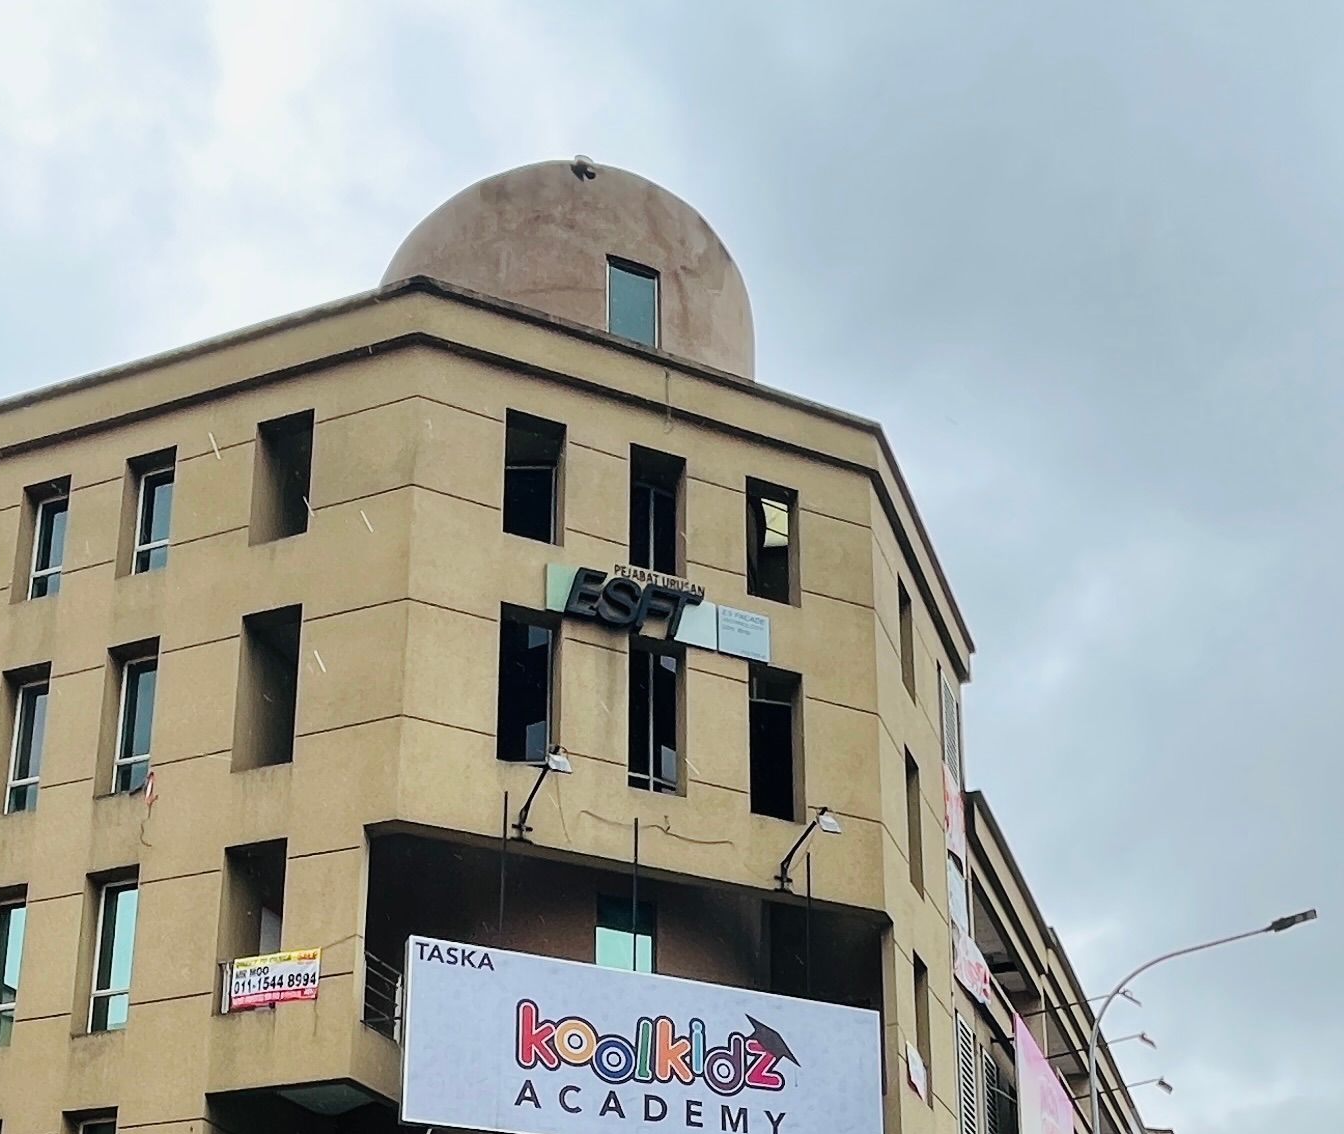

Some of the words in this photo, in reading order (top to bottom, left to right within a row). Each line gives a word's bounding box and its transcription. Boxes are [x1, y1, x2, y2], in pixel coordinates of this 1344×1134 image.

[613, 563, 658, 585] PEJABAT
[415, 941, 495, 972] TASKA
[233, 974, 284, 995] 011-1544
[287, 972, 317, 988] 8994
[249, 966, 270, 978] MOO
[515, 998, 786, 1096] koolkidz
